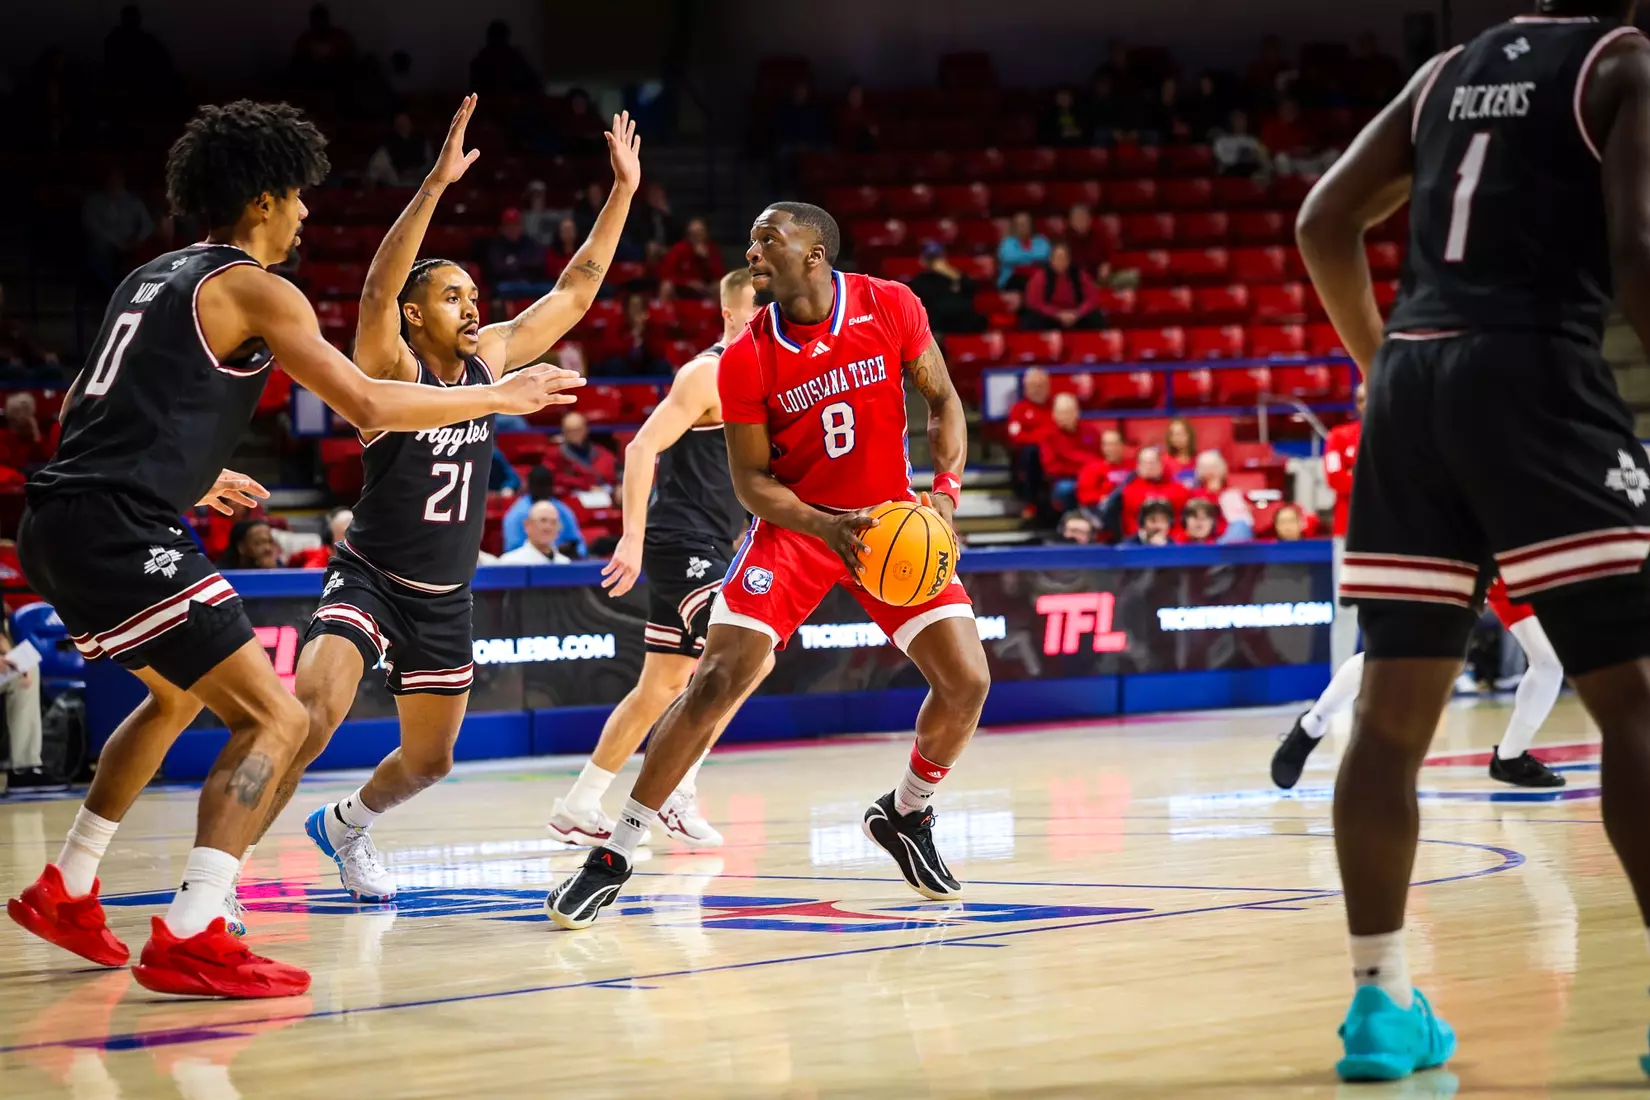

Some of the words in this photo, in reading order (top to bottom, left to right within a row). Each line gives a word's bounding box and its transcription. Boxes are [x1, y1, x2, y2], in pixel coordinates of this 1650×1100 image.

[1448, 82, 1536, 121] PICKENS
[1442, 130, 1492, 263] 1
[84, 310, 145, 398] 0
[777, 366, 850, 414] LOUISIANA
[848, 355, 887, 389] TECH
[820, 400, 856, 459] 8
[422, 460, 474, 523] 21
[926, 550, 949, 597] NCAA
[472, 633, 616, 665] ORLESS.COM
[1035, 591, 1129, 656] TFL
